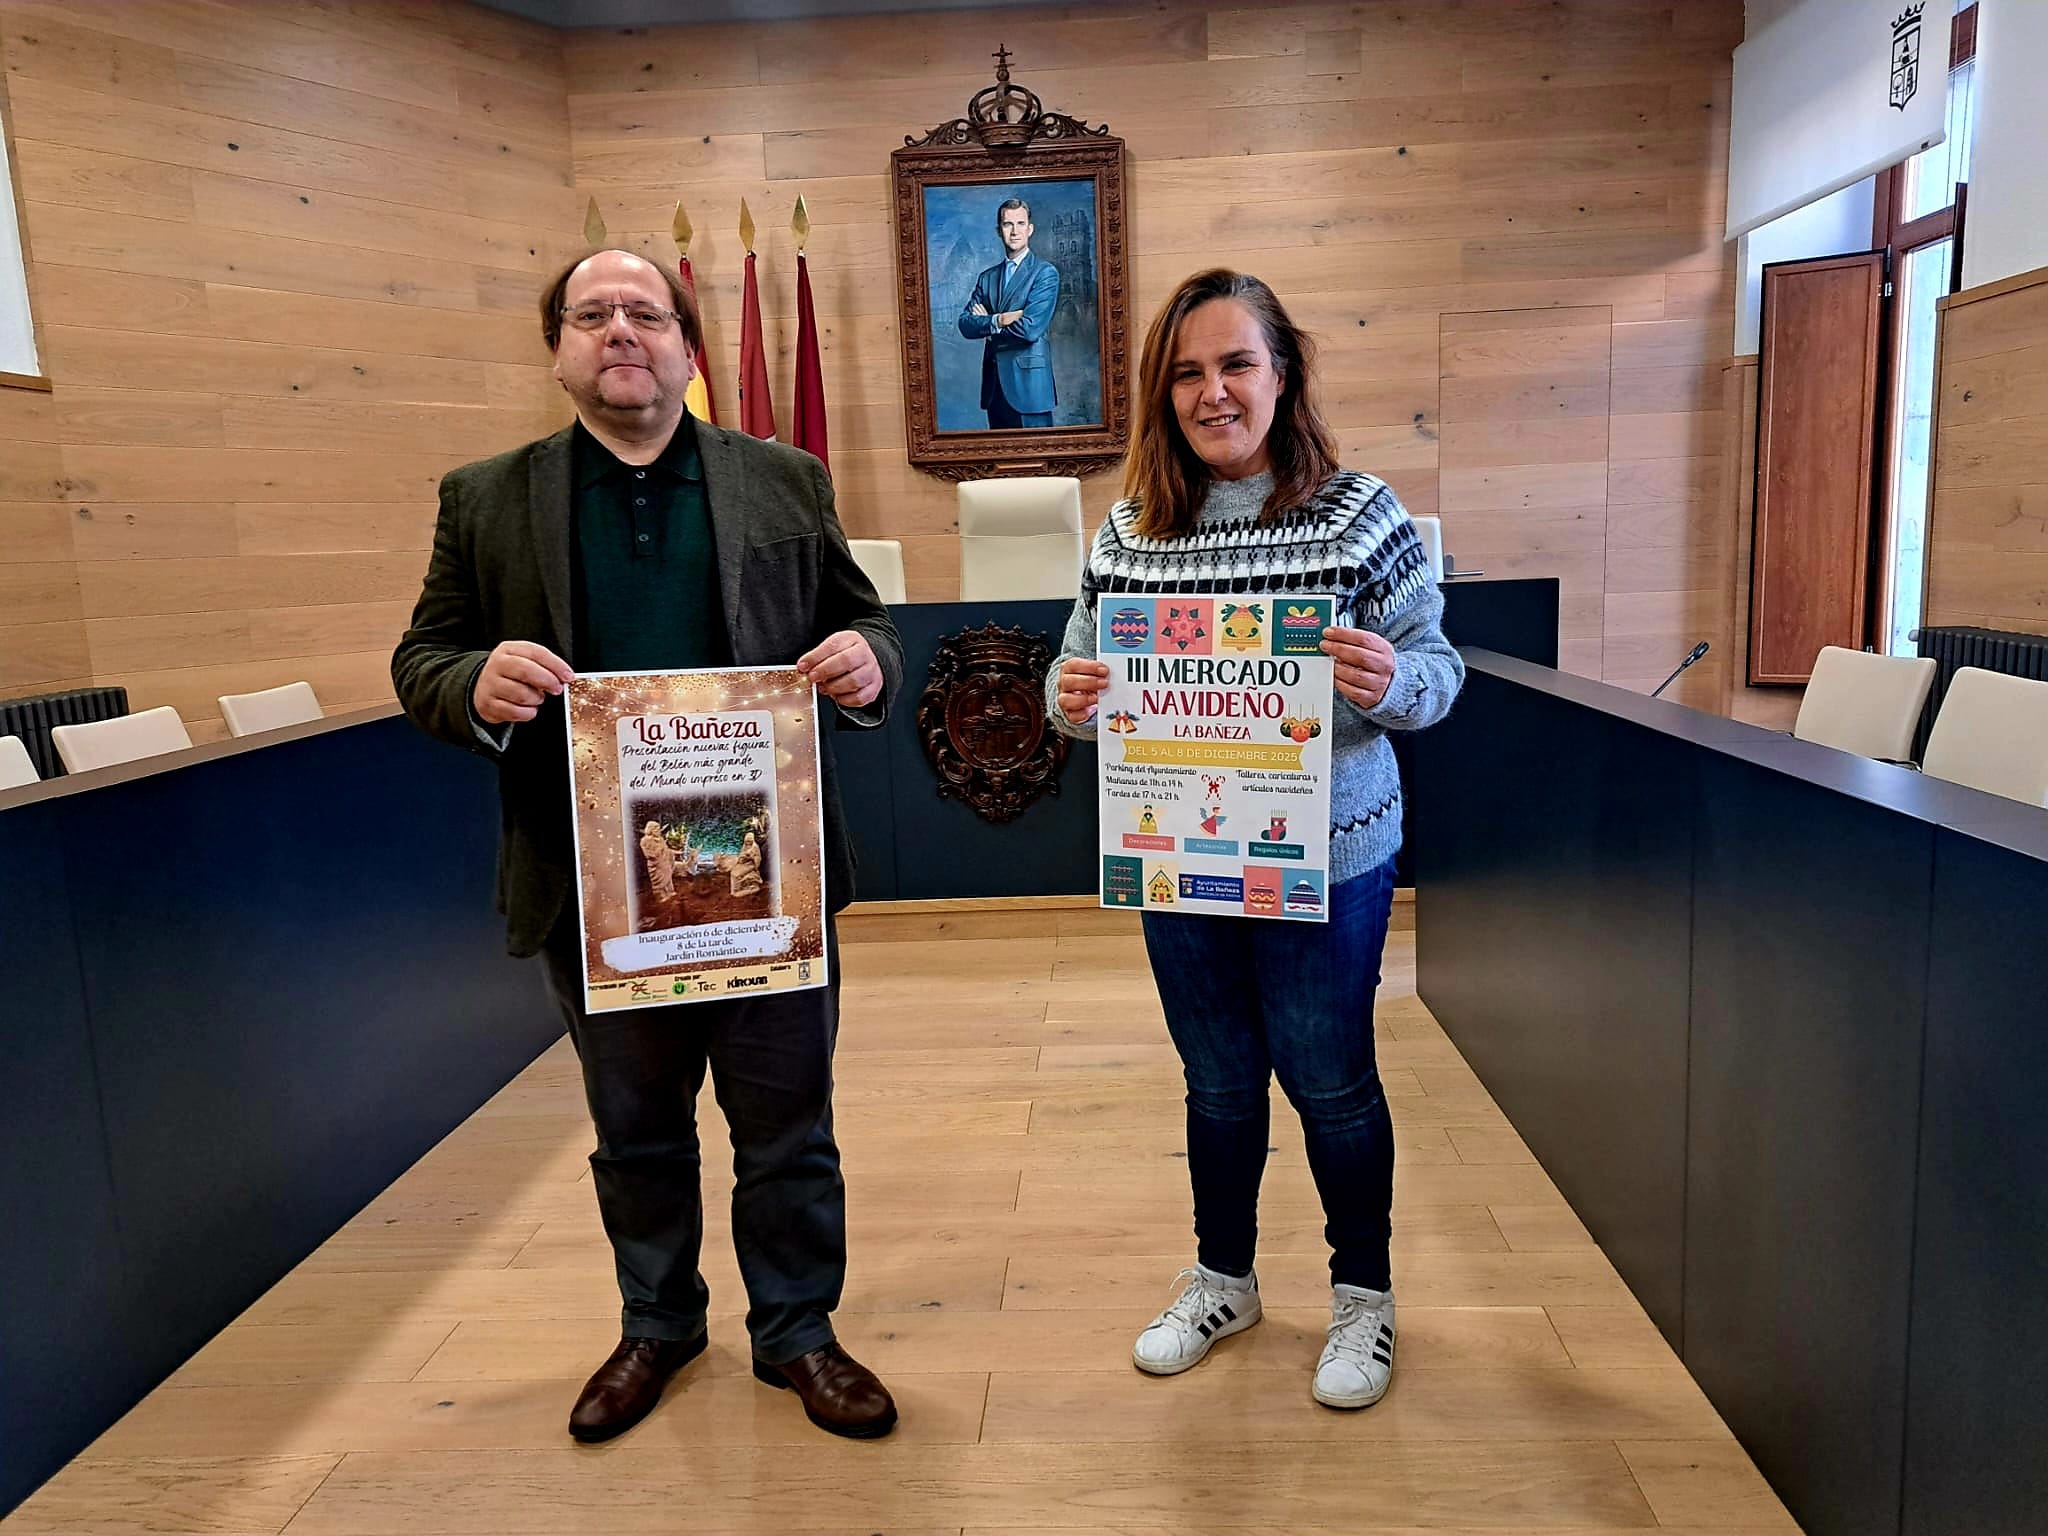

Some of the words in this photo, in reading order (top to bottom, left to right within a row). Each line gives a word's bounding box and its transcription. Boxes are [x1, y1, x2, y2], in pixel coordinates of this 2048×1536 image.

[1127, 657, 1149, 683] III
[1157, 658, 1301, 687] MERCADO
[1141, 686, 1285, 719] NAVIDEÑO
[633, 717, 666, 746] La
[669, 715, 762, 740] Bañeza
[1174, 724, 1192, 738] LA
[1195, 723, 1251, 740] BAÑEZA
[622, 743, 690, 758] Presentación
[693, 742, 730, 753] nuevas
[732, 739, 770, 757] figuras
[1127, 746, 1147, 756] DEL
[1151, 747, 1158, 756] 5
[1160, 747, 1175, 756] AL
[1176, 748, 1183, 757] 8
[1186, 748, 1201, 758] DE
[1203, 749, 1268, 761] DICIEMBRE
[1271, 751, 1298, 762] 2025
[640, 760, 656, 772] del
[659, 759, 692, 772] Belén
[694, 758, 714, 768] más
[717, 755, 753, 774] grande
[1104, 762, 1134, 774] Parking
[1135, 765, 1145, 773] del
[1146, 766, 1197, 776] Ayuntamiento
[629, 776, 646, 788] del
[650, 774, 687, 788] Mundo
[690, 774, 729, 788] impreso
[749, 769, 762, 782] 3D
[1105, 775, 1138, 785] Mañanas
[1177, 780, 1183, 788] h
[1268, 772, 1311, 781] caricaturas
[1312, 775, 1318, 783] y
[1105, 788, 1130, 797] Tardes
[1132, 790, 1140, 798] de
[1142, 790, 1149, 799] 17
[1151, 791, 1156, 799] h
[1164, 792, 1172, 800] 21
[1174, 792, 1180, 800] h
[1241, 784, 1273, 793] artículos
[1275, 786, 1314, 795] navideños
[638, 930, 702, 944] Inauguración
[703, 929, 710, 937] 6
[711, 928, 724, 936] de
[724, 921, 772, 935] diciembre
[684, 941, 697, 949] de
[698, 940, 708, 948] la
[708, 937, 734, 947] tarde
[696, 947, 748, 959] Romántico
